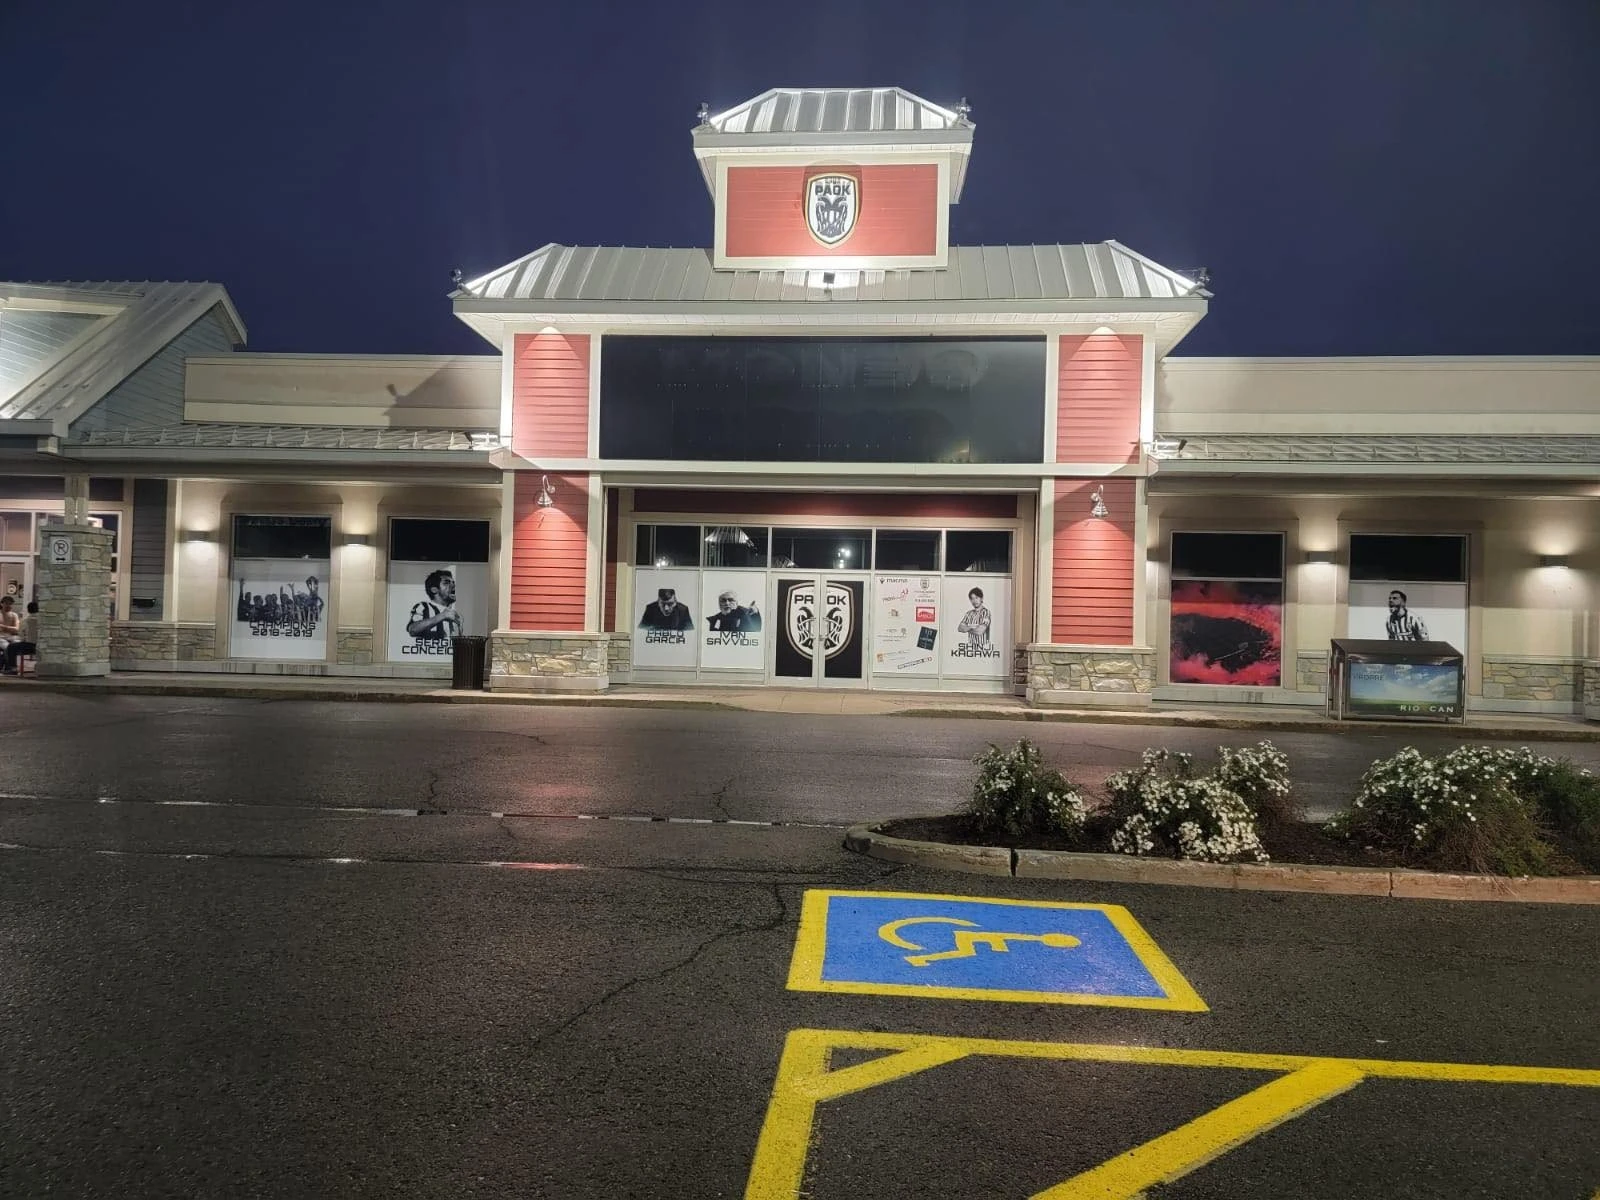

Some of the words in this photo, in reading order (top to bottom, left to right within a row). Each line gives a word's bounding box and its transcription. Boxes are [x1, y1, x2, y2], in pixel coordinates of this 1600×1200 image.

[815, 185, 851, 196] PAOK
[249, 620, 316, 630] CHAMPIONS
[252, 628, 313, 637] 2018-2019
[647, 629, 684, 637] PABLO
[720, 631, 746, 639] IVAN
[415, 638, 453, 647] SERGI
[645, 636, 686, 644] GARCIA
[402, 645, 454, 655] CONCEIC
[959, 643, 994, 651] SHINJI
[951, 650, 1000, 658] KAGAWA
[1400, 704, 1420, 712] RIO
[1429, 705, 1454, 713] CAN
